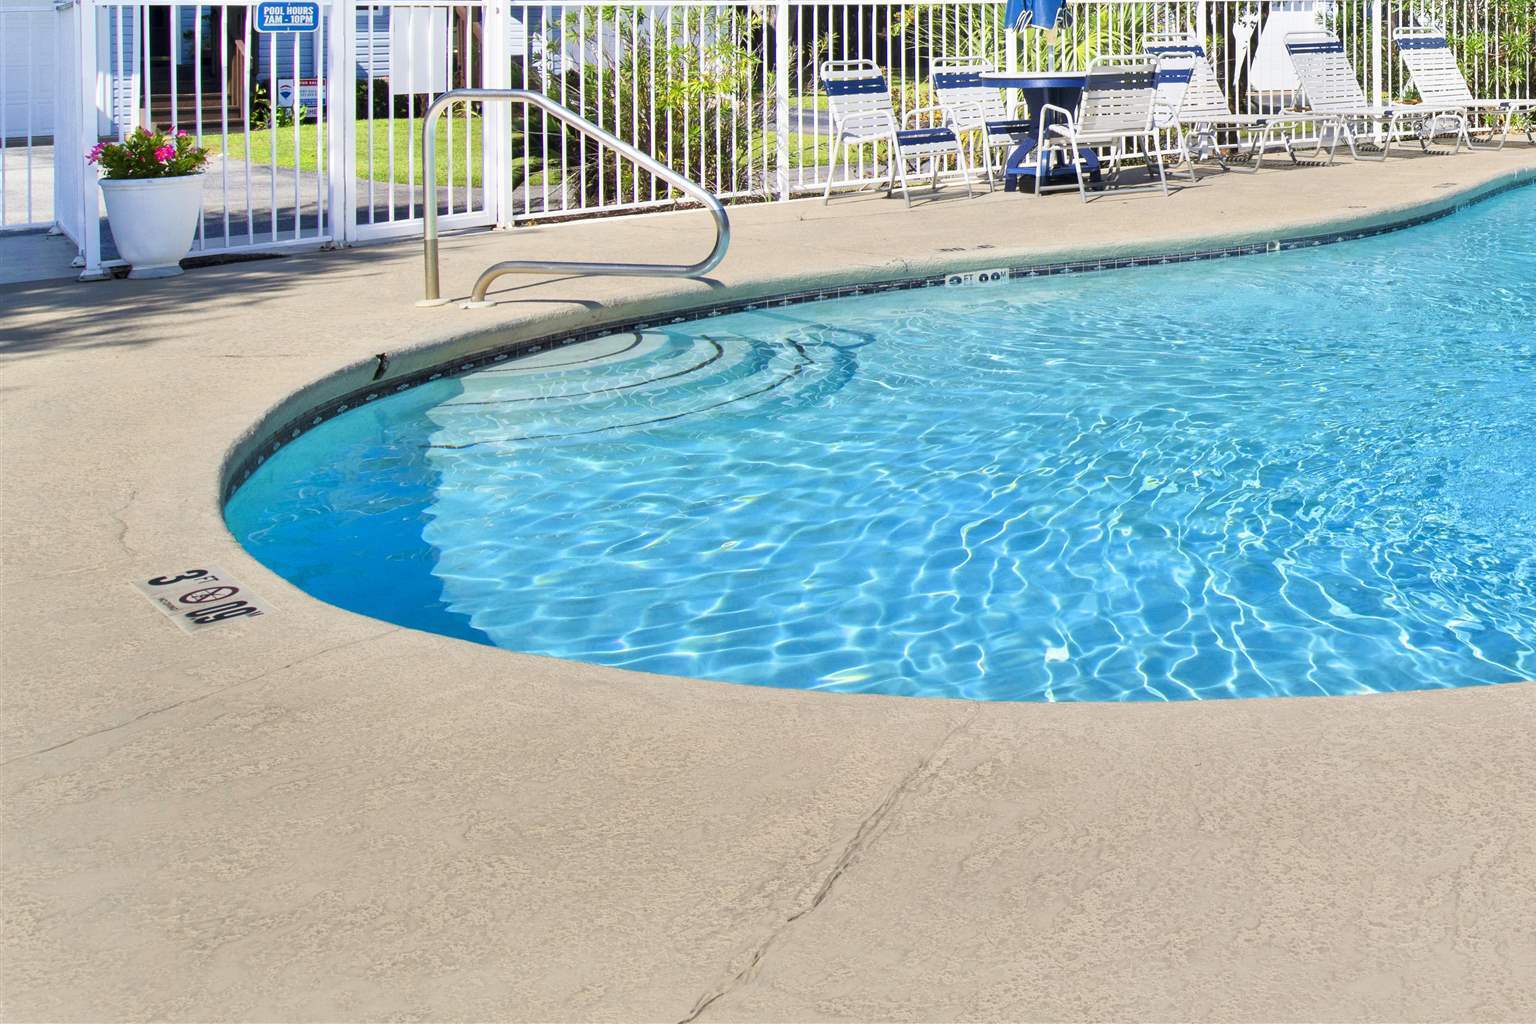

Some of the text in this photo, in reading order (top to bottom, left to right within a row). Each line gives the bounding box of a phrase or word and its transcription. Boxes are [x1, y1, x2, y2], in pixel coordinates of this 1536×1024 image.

[263, 6, 314, 15] POOL HOURS
[263, 15, 283, 24] 7AM
[291, 15, 314, 24] 10PM
[148, 569, 209, 586] 3
